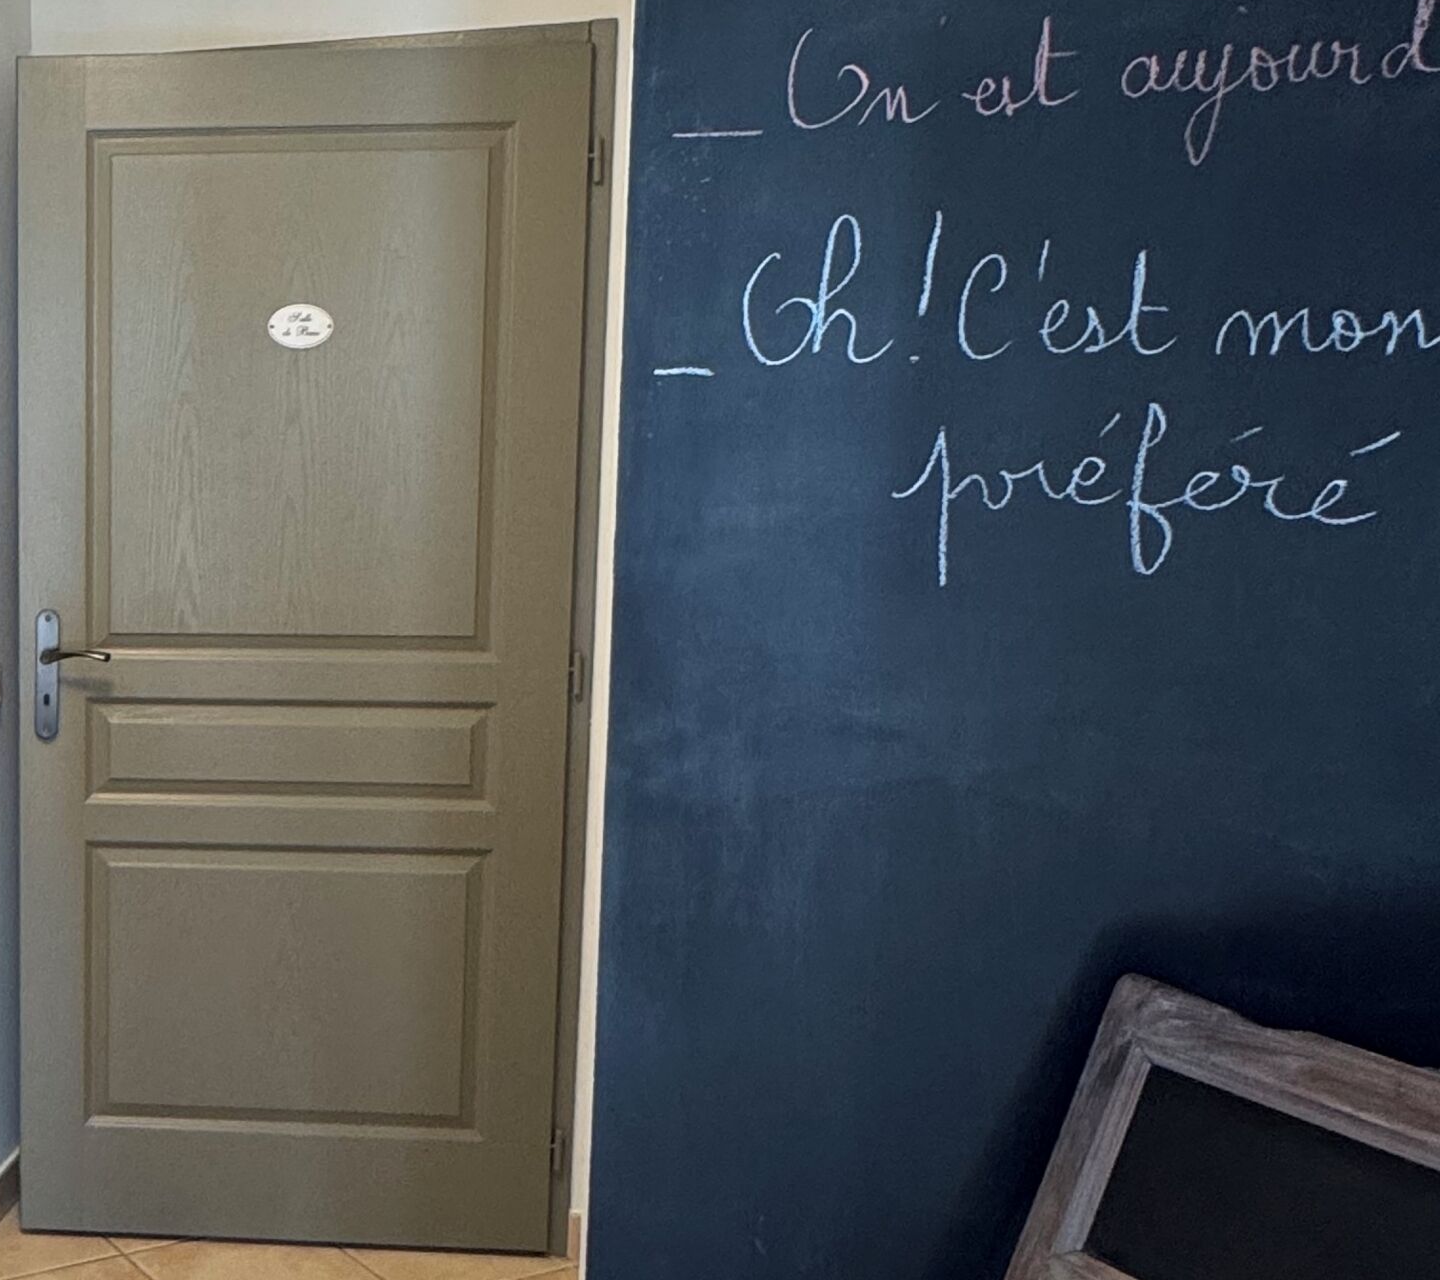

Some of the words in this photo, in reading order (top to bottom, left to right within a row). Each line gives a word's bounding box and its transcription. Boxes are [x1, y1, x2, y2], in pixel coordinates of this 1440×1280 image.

[787, 27, 941, 129] On
[962, 16, 1079, 118] est
[1215, 304, 1440, 358] mon
